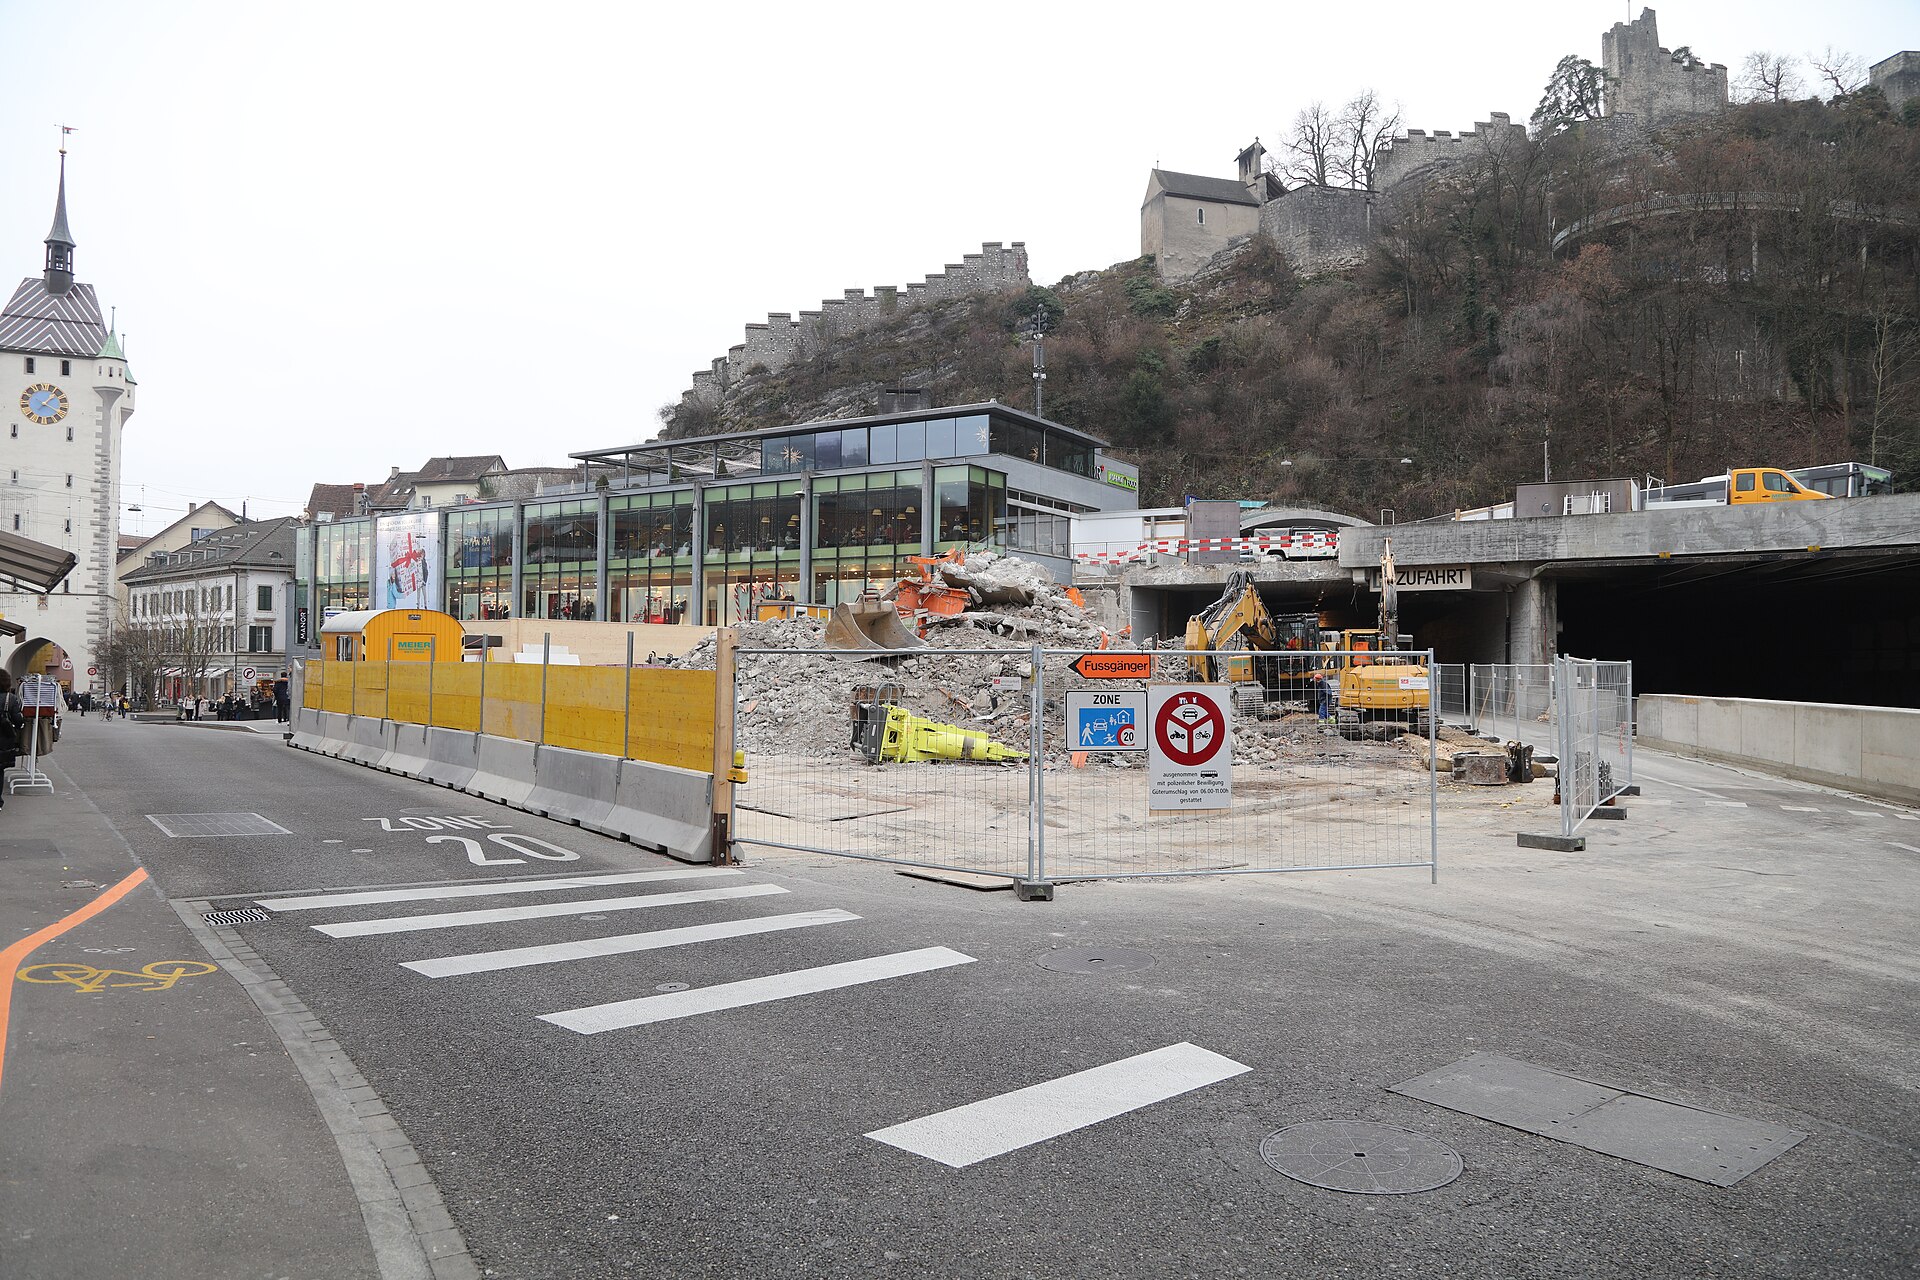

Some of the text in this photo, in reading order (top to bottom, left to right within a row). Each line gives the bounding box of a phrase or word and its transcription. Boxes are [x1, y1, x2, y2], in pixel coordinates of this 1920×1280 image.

[1396, 568, 1467, 586] ZUFAHRT
[1084, 660, 1149, 673] Fussgänger
[1092, 694, 1121, 705] ZONE
[1123, 731, 1134, 742] 20
[361, 815, 513, 832] ZONE
[425, 833, 581, 867] 20
